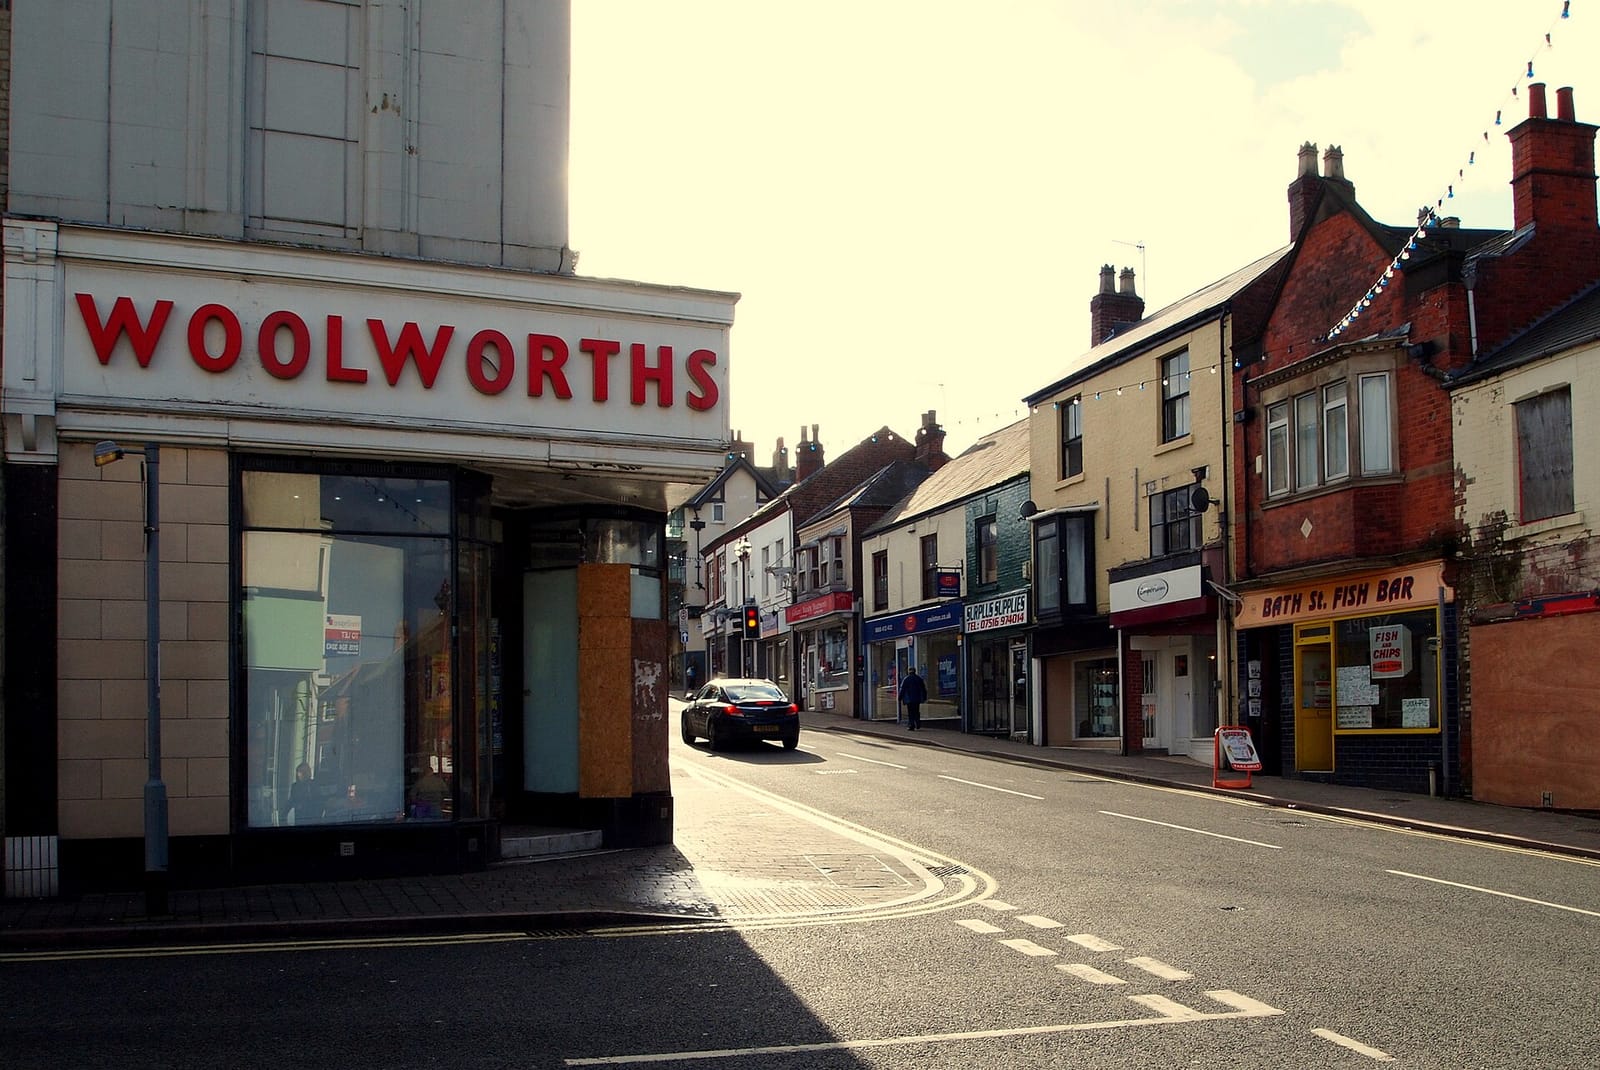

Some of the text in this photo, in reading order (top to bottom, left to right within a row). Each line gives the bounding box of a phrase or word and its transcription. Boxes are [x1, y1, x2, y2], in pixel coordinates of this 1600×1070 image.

[75, 293, 720, 412] WOOLWORTHS
[1262, 575, 1415, 618] BATH St. FISH BAR
[967, 613, 1025, 632] TEL: 07516 974014
[1375, 631, 1398, 642] FISH
[1373, 648, 1401, 659] CHIPS
